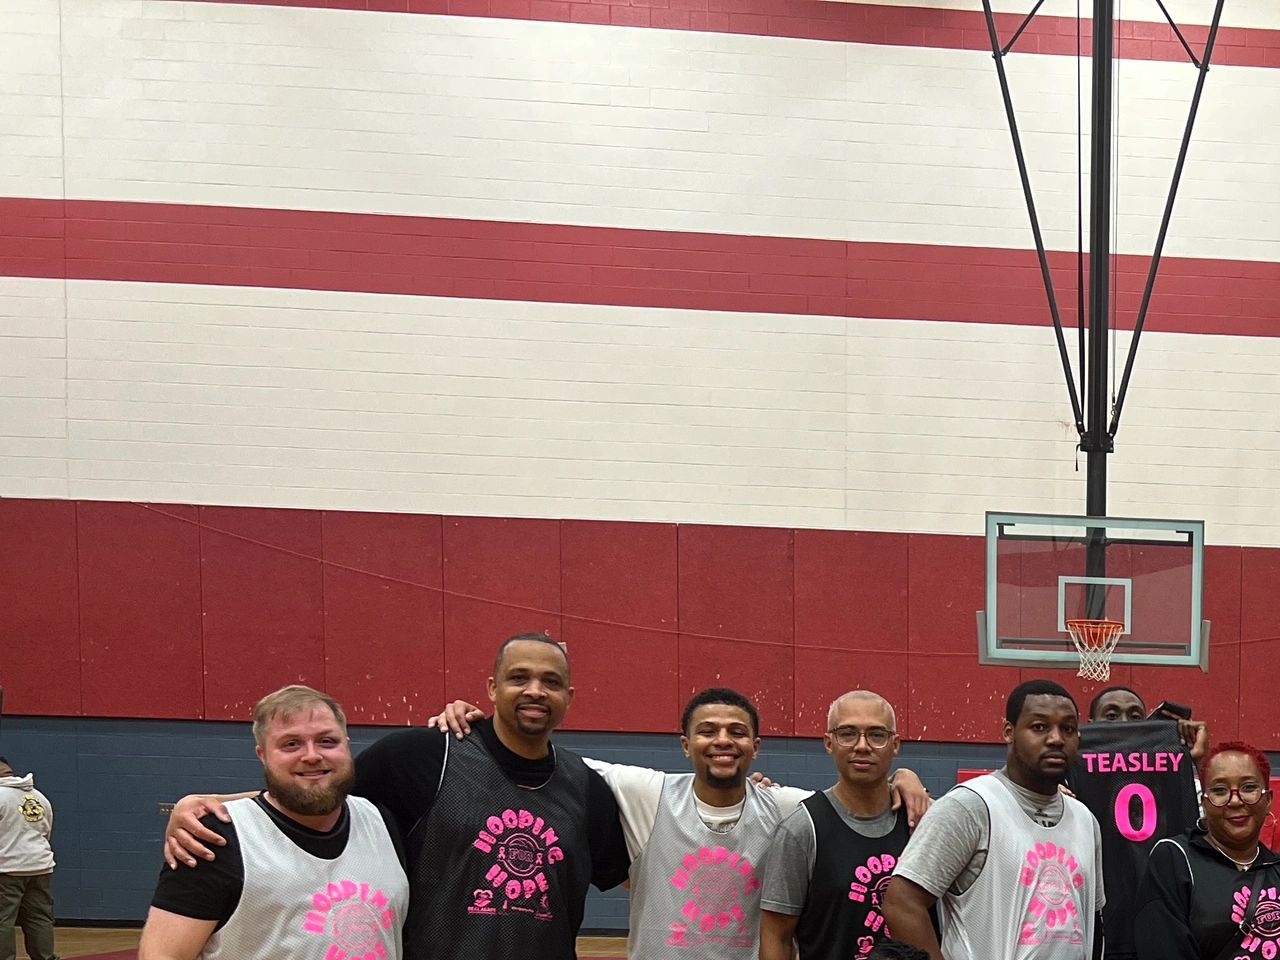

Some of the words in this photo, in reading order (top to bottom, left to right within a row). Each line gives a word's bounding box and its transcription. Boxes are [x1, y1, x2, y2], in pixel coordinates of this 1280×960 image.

[1082, 752, 1184, 773] TEASLEY
[1114, 782, 1158, 843] 0
[472, 808, 565, 865] HOOPING
[485, 863, 550, 900] HOPE
